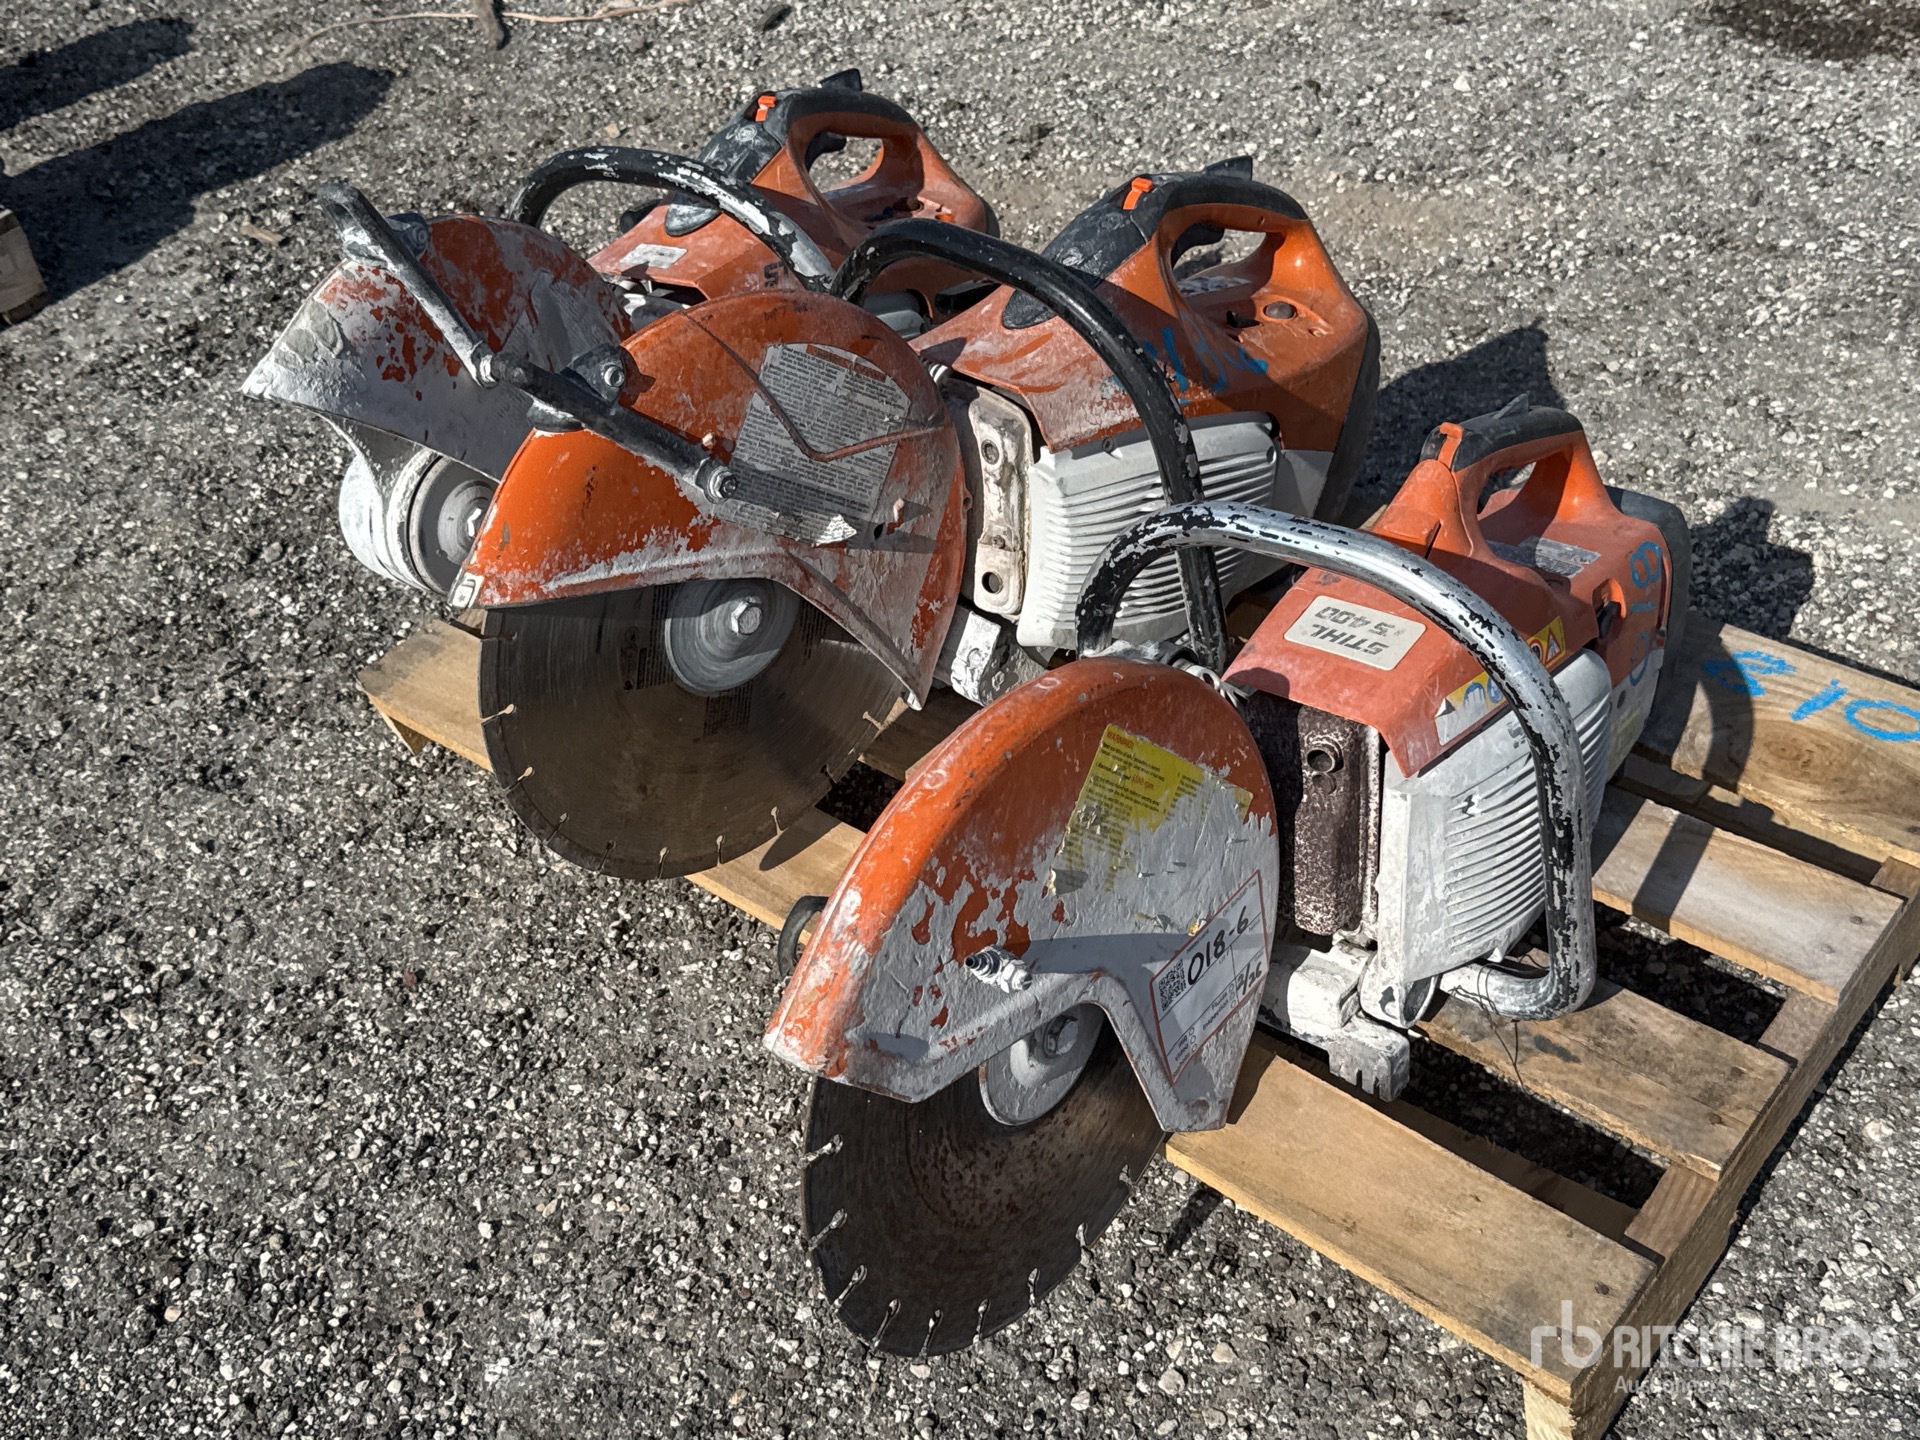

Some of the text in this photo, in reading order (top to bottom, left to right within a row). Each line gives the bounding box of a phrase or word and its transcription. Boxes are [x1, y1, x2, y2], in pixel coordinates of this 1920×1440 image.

[1314, 606, 1371, 629] 400
[1310, 623, 1390, 655] STIHL
[1187, 905, 1249, 986] 018-6
